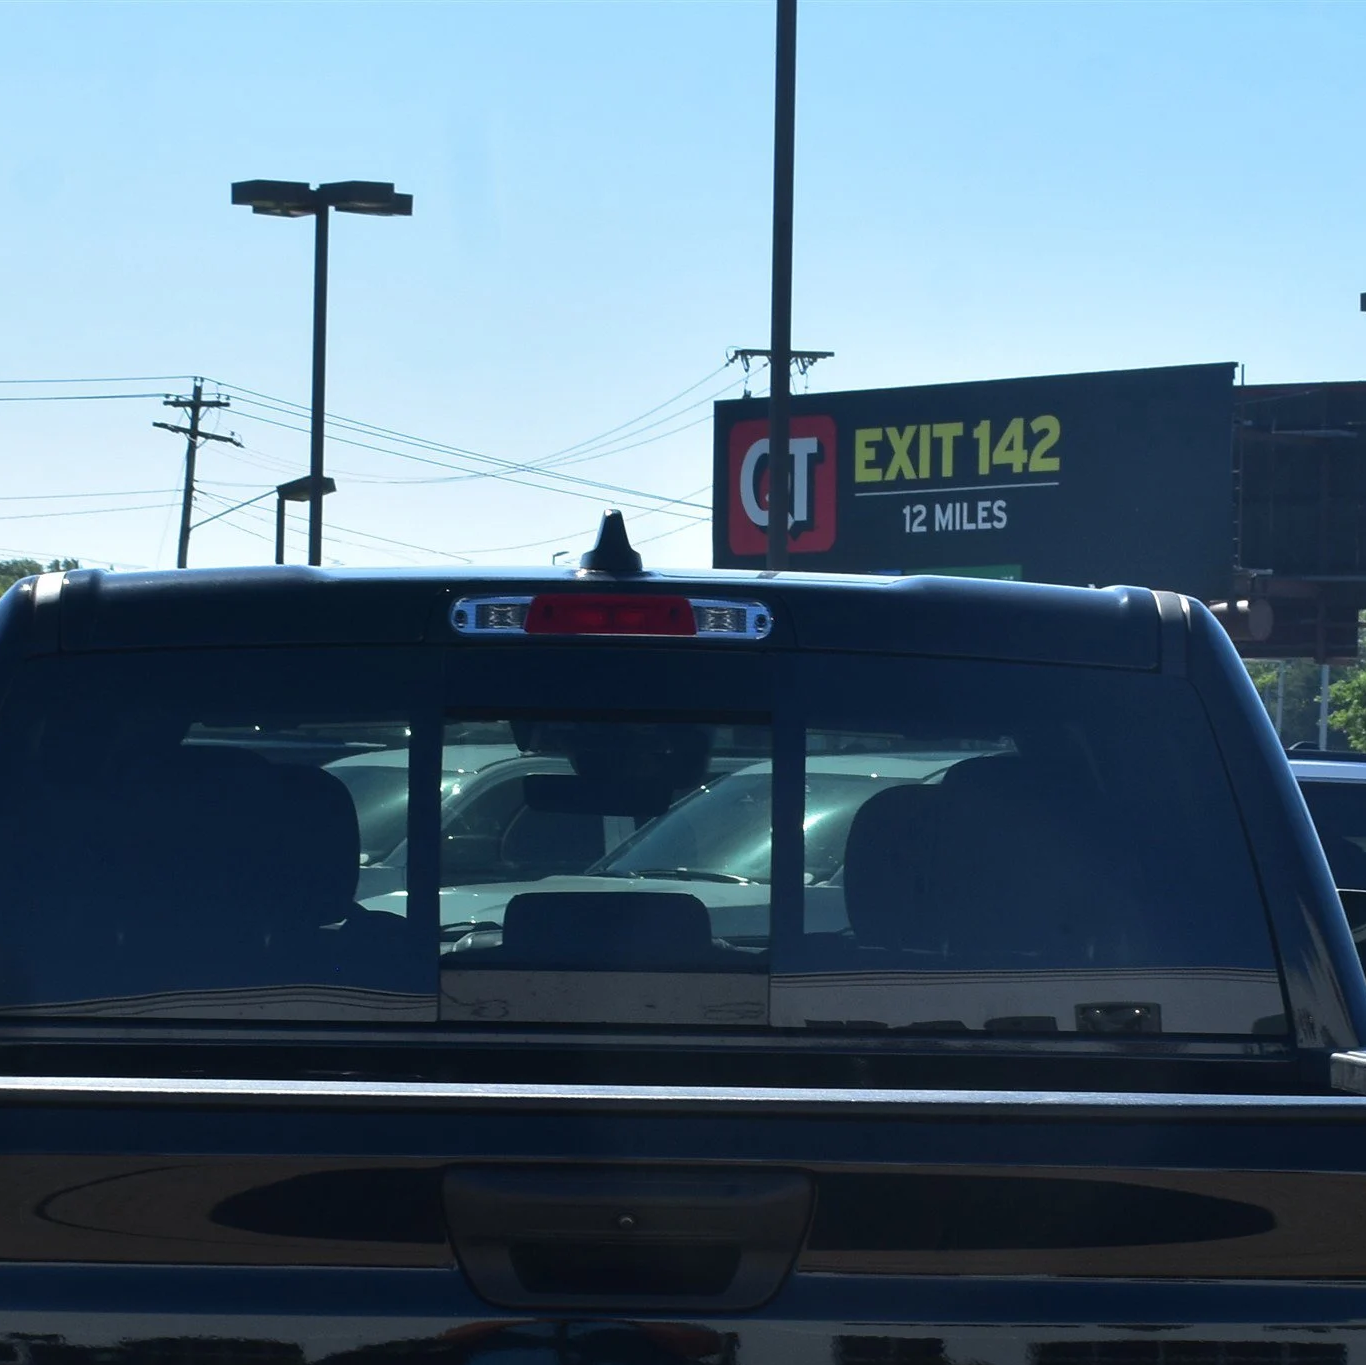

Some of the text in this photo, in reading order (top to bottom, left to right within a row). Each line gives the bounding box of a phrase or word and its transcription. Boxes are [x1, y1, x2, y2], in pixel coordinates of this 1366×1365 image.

[855, 415, 1061, 483] EXIT 142
[902, 500, 1008, 533] 12 MILES
